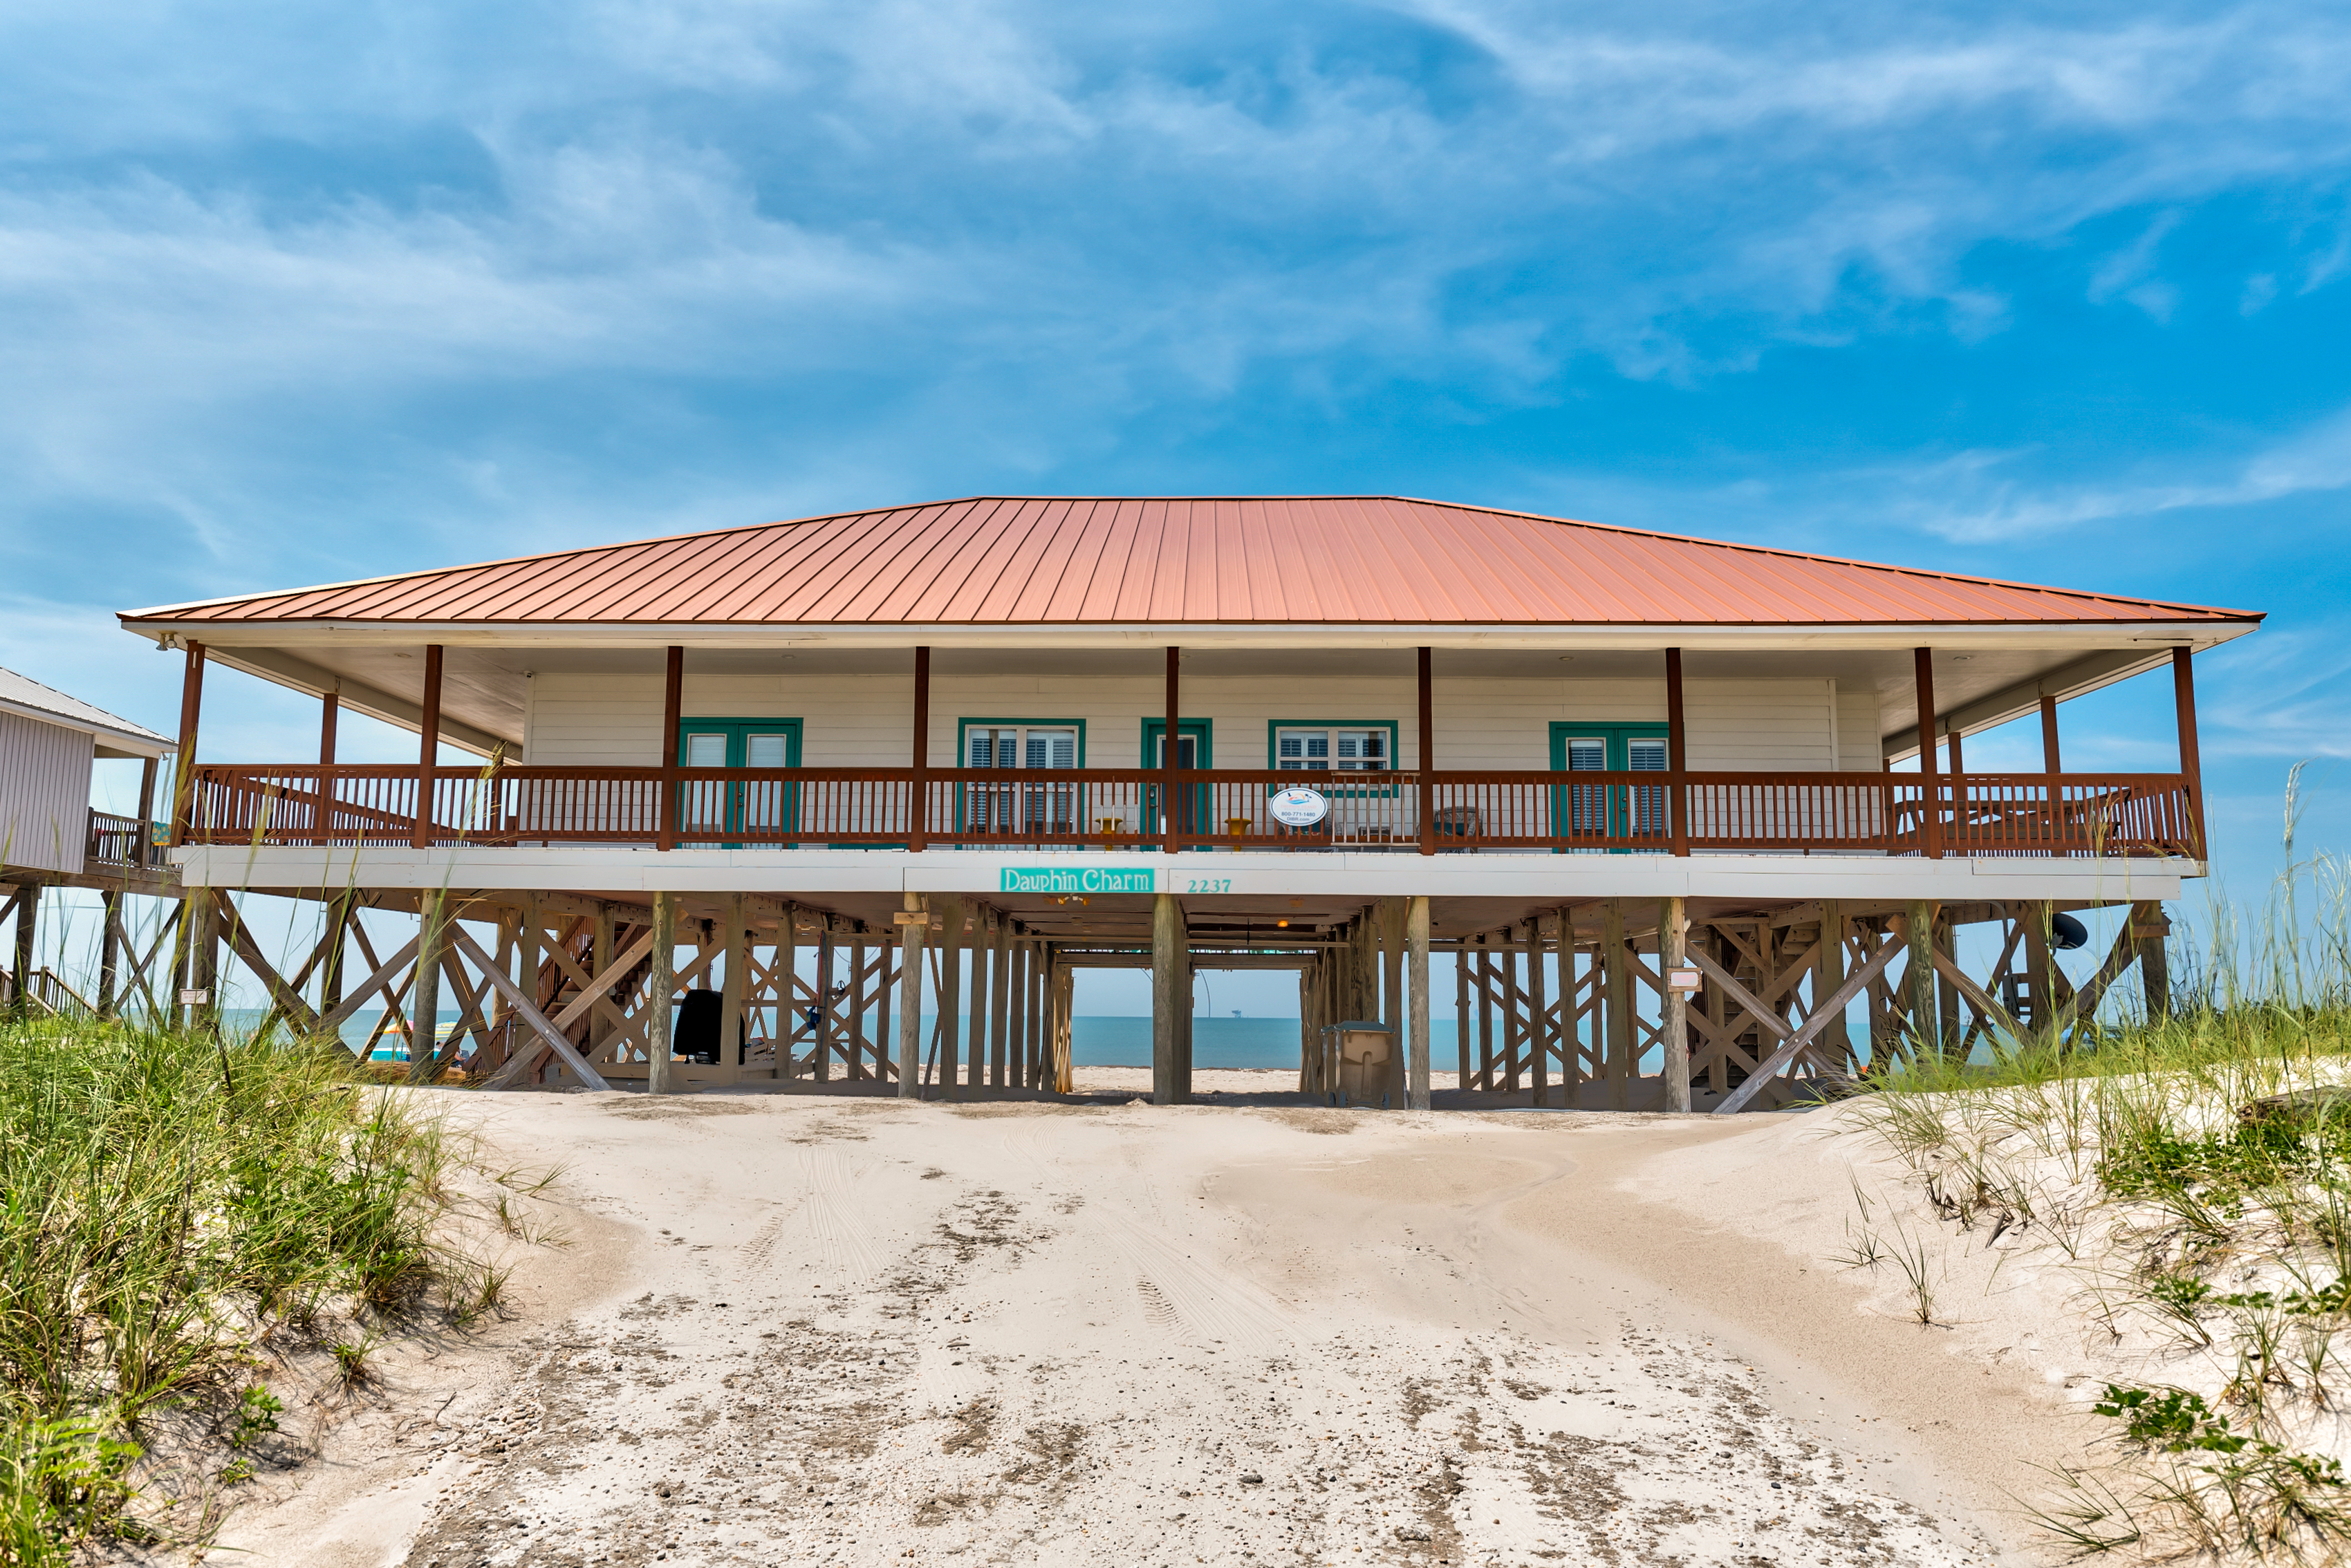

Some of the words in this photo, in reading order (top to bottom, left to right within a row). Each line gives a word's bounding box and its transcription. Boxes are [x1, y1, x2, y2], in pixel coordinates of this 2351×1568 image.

[1005, 869, 1078, 892] Dauphin
[1082, 869, 1149, 890] Charm
[1188, 879, 1232, 893] 2237
